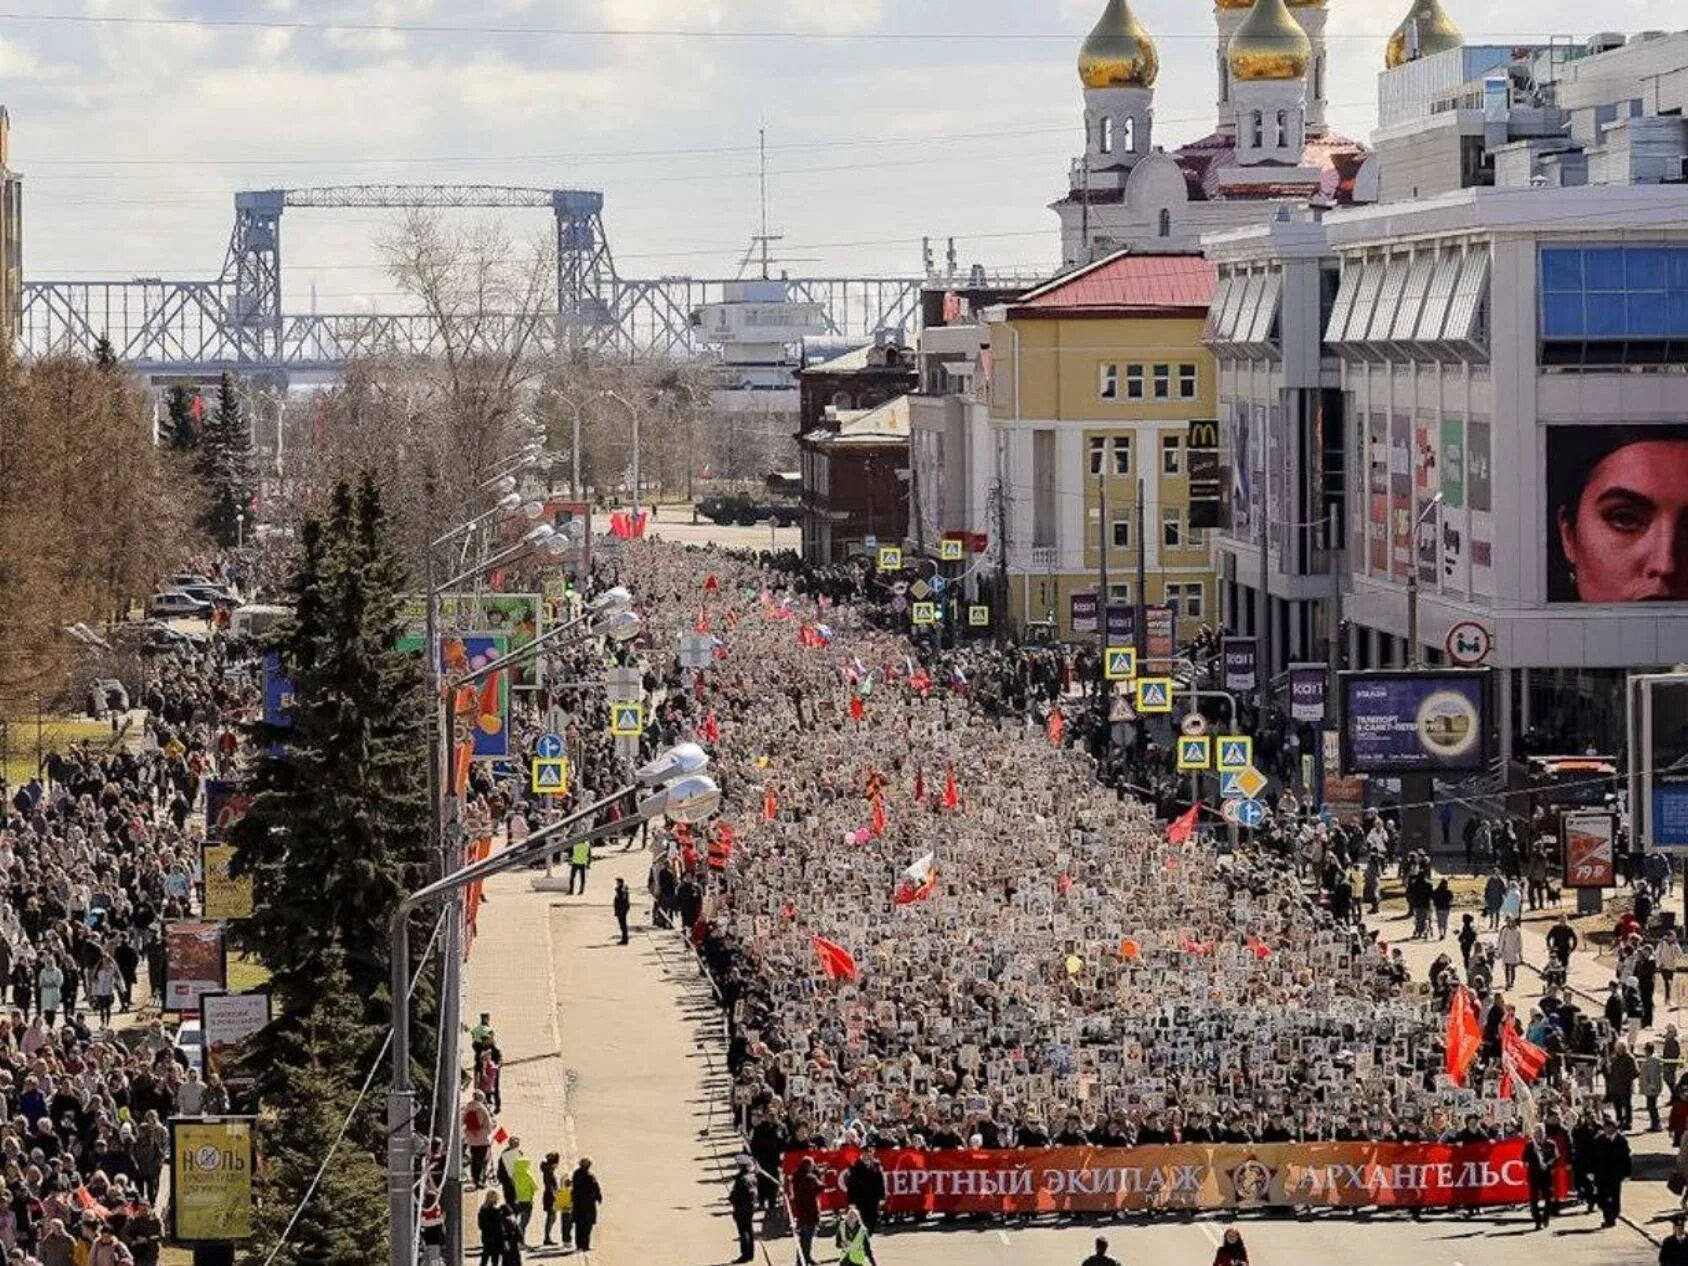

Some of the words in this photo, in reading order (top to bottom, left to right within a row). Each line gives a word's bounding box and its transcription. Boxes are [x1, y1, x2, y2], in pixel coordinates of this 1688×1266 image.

[1292, 681, 1324, 696] kari
[1042, 1164, 1206, 1195] ЭКИПАЖ
[1299, 1160, 1528, 1191] АРХАНГЕЛЬС
